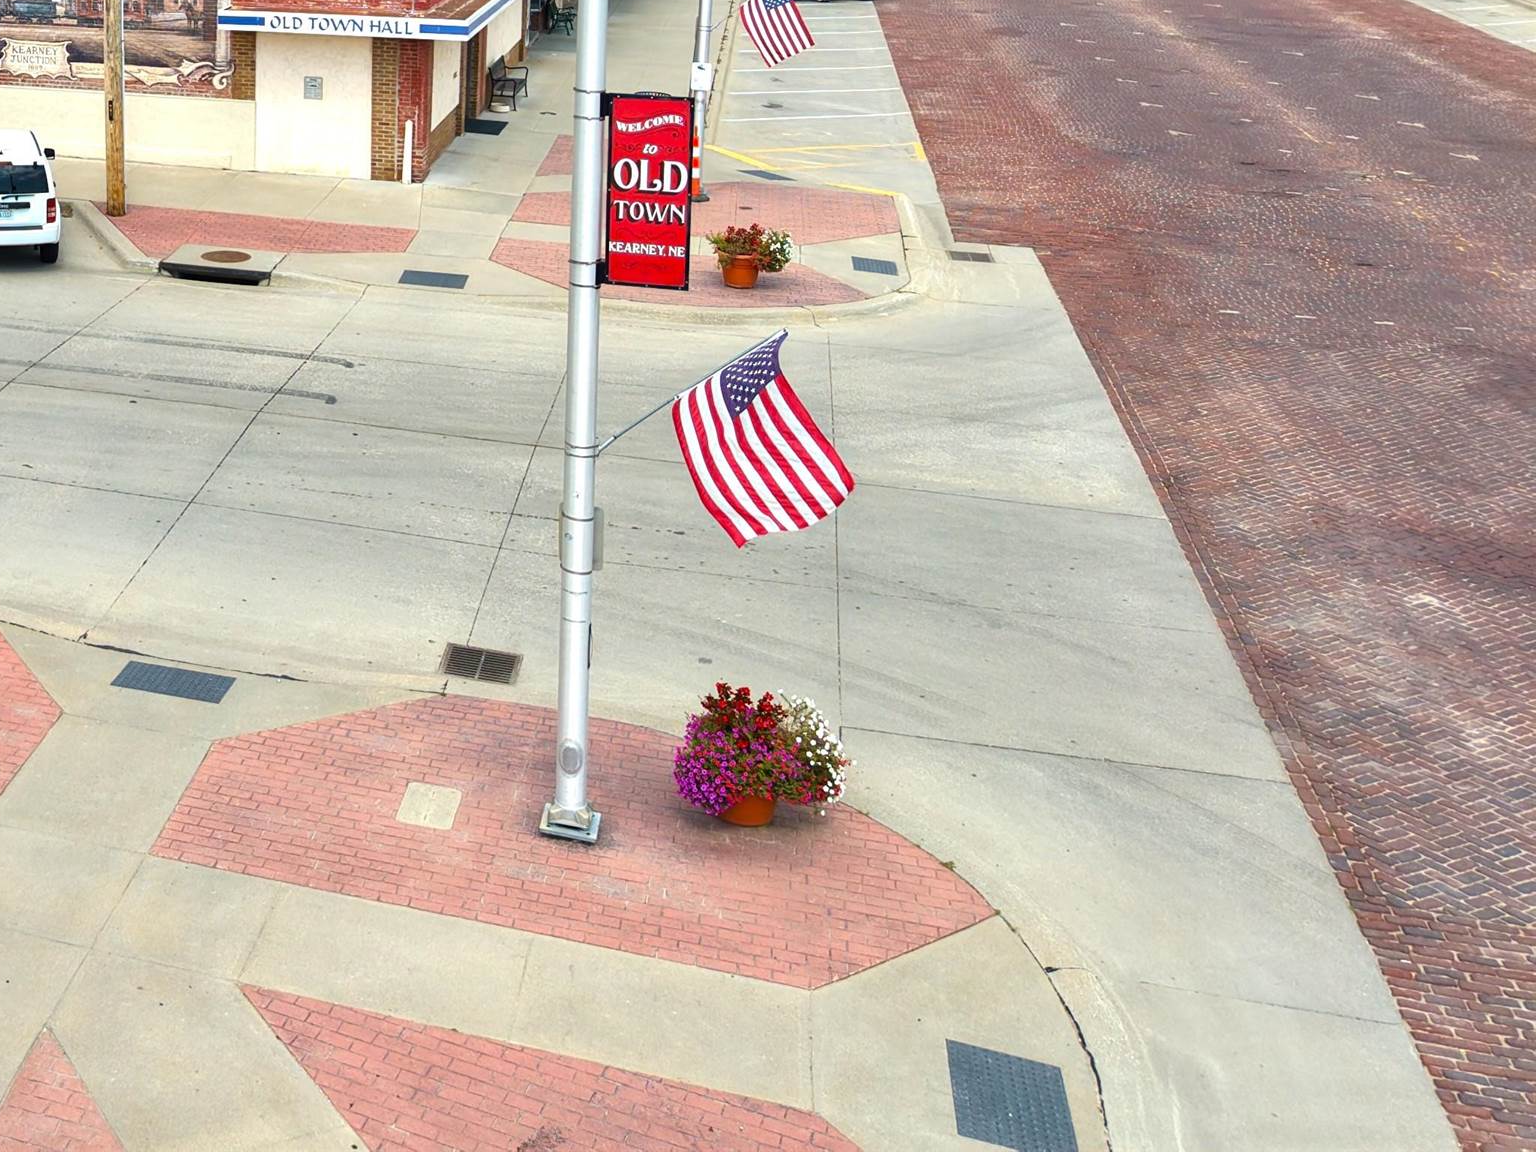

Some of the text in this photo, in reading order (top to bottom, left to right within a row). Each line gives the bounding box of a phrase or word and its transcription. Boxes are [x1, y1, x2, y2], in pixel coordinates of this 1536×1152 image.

[269, 15, 414, 36] OLD TOWN HALL
[11, 45, 58, 56] KEARNEY
[10, 54, 57, 65] JUNCTION
[616, 113, 685, 134] WELCOME
[642, 143, 659, 155] to
[613, 157, 689, 194] OLD
[613, 199, 687, 225] TOWN
[668, 245, 686, 258] NE
